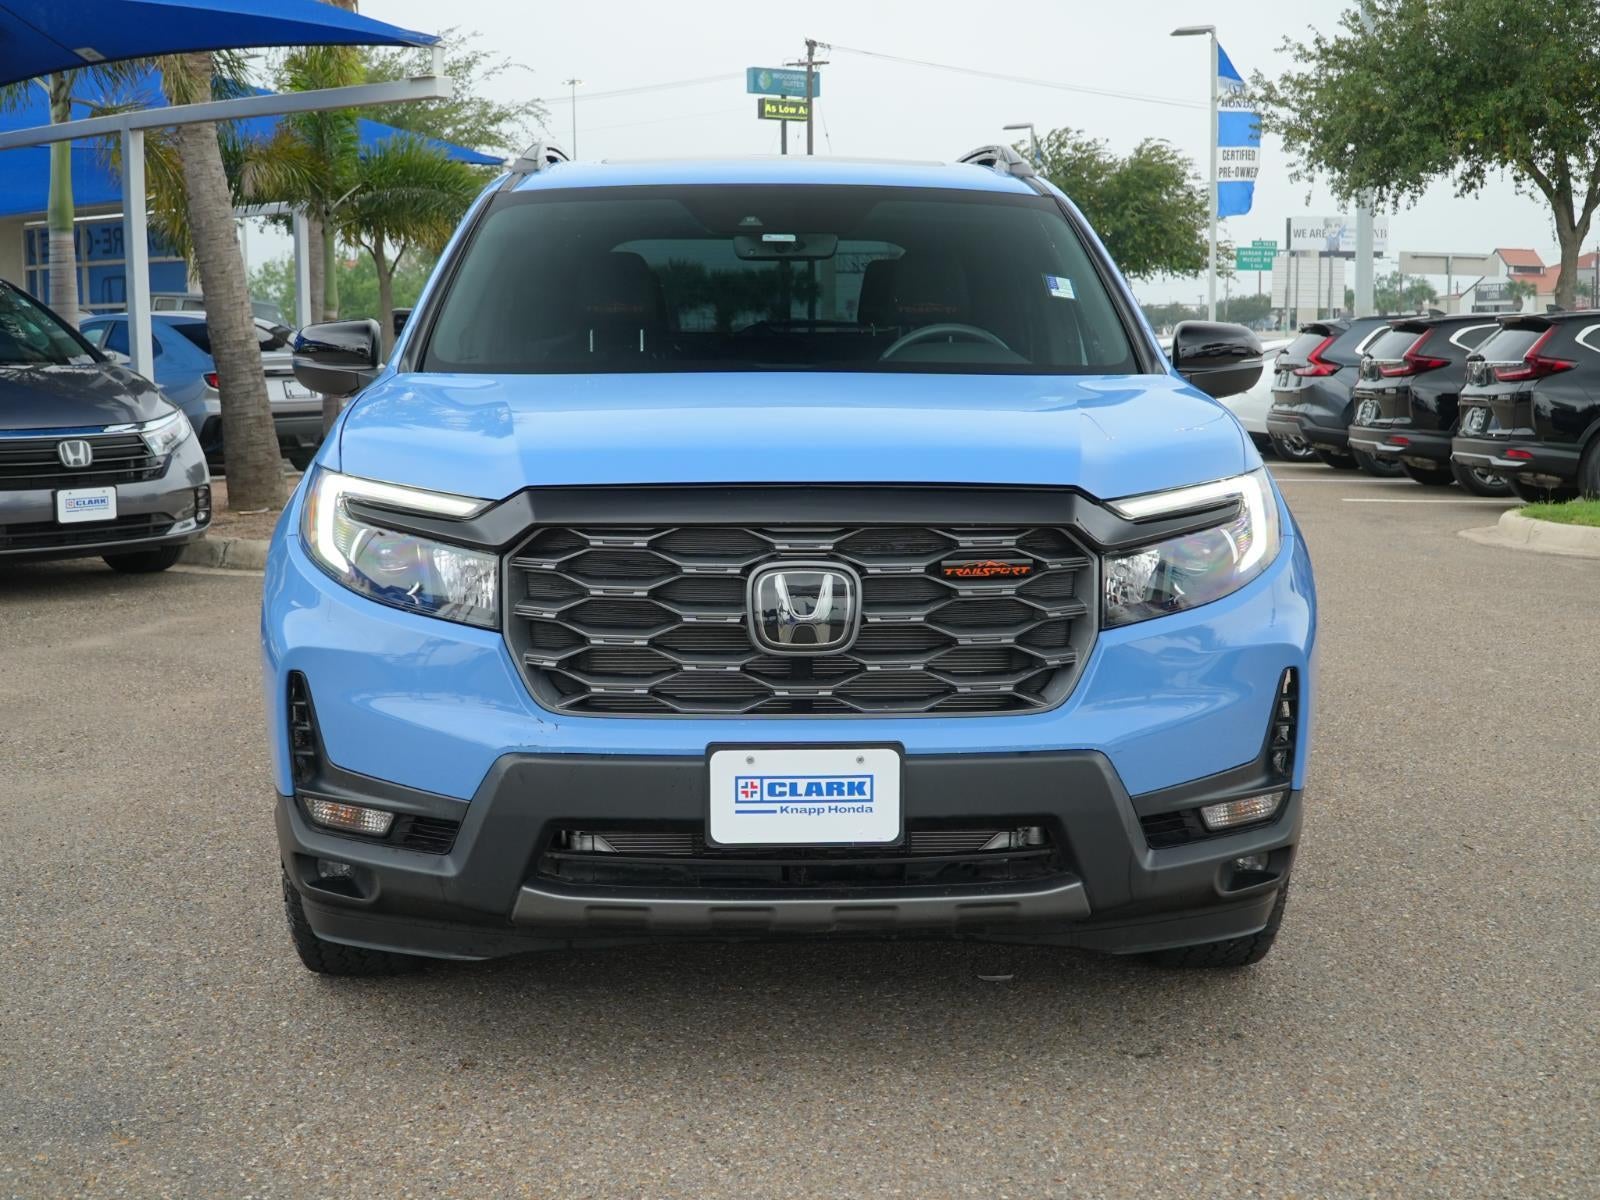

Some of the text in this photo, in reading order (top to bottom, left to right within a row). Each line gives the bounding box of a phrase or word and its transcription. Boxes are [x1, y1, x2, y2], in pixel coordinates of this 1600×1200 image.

[765, 104, 776, 112] As
[779, 105, 796, 114] Low
[1222, 149, 1255, 161] CERTIFIED
[1218, 167, 1258, 178] PRE-OWNED
[1293, 228, 1306, 238] WE
[1309, 228, 1326, 238] ARE
[943, 566, 1031, 577] TRAILSPORT
[767, 781, 867, 797] CLARK
[779, 805, 873, 816] Knapp Honda
